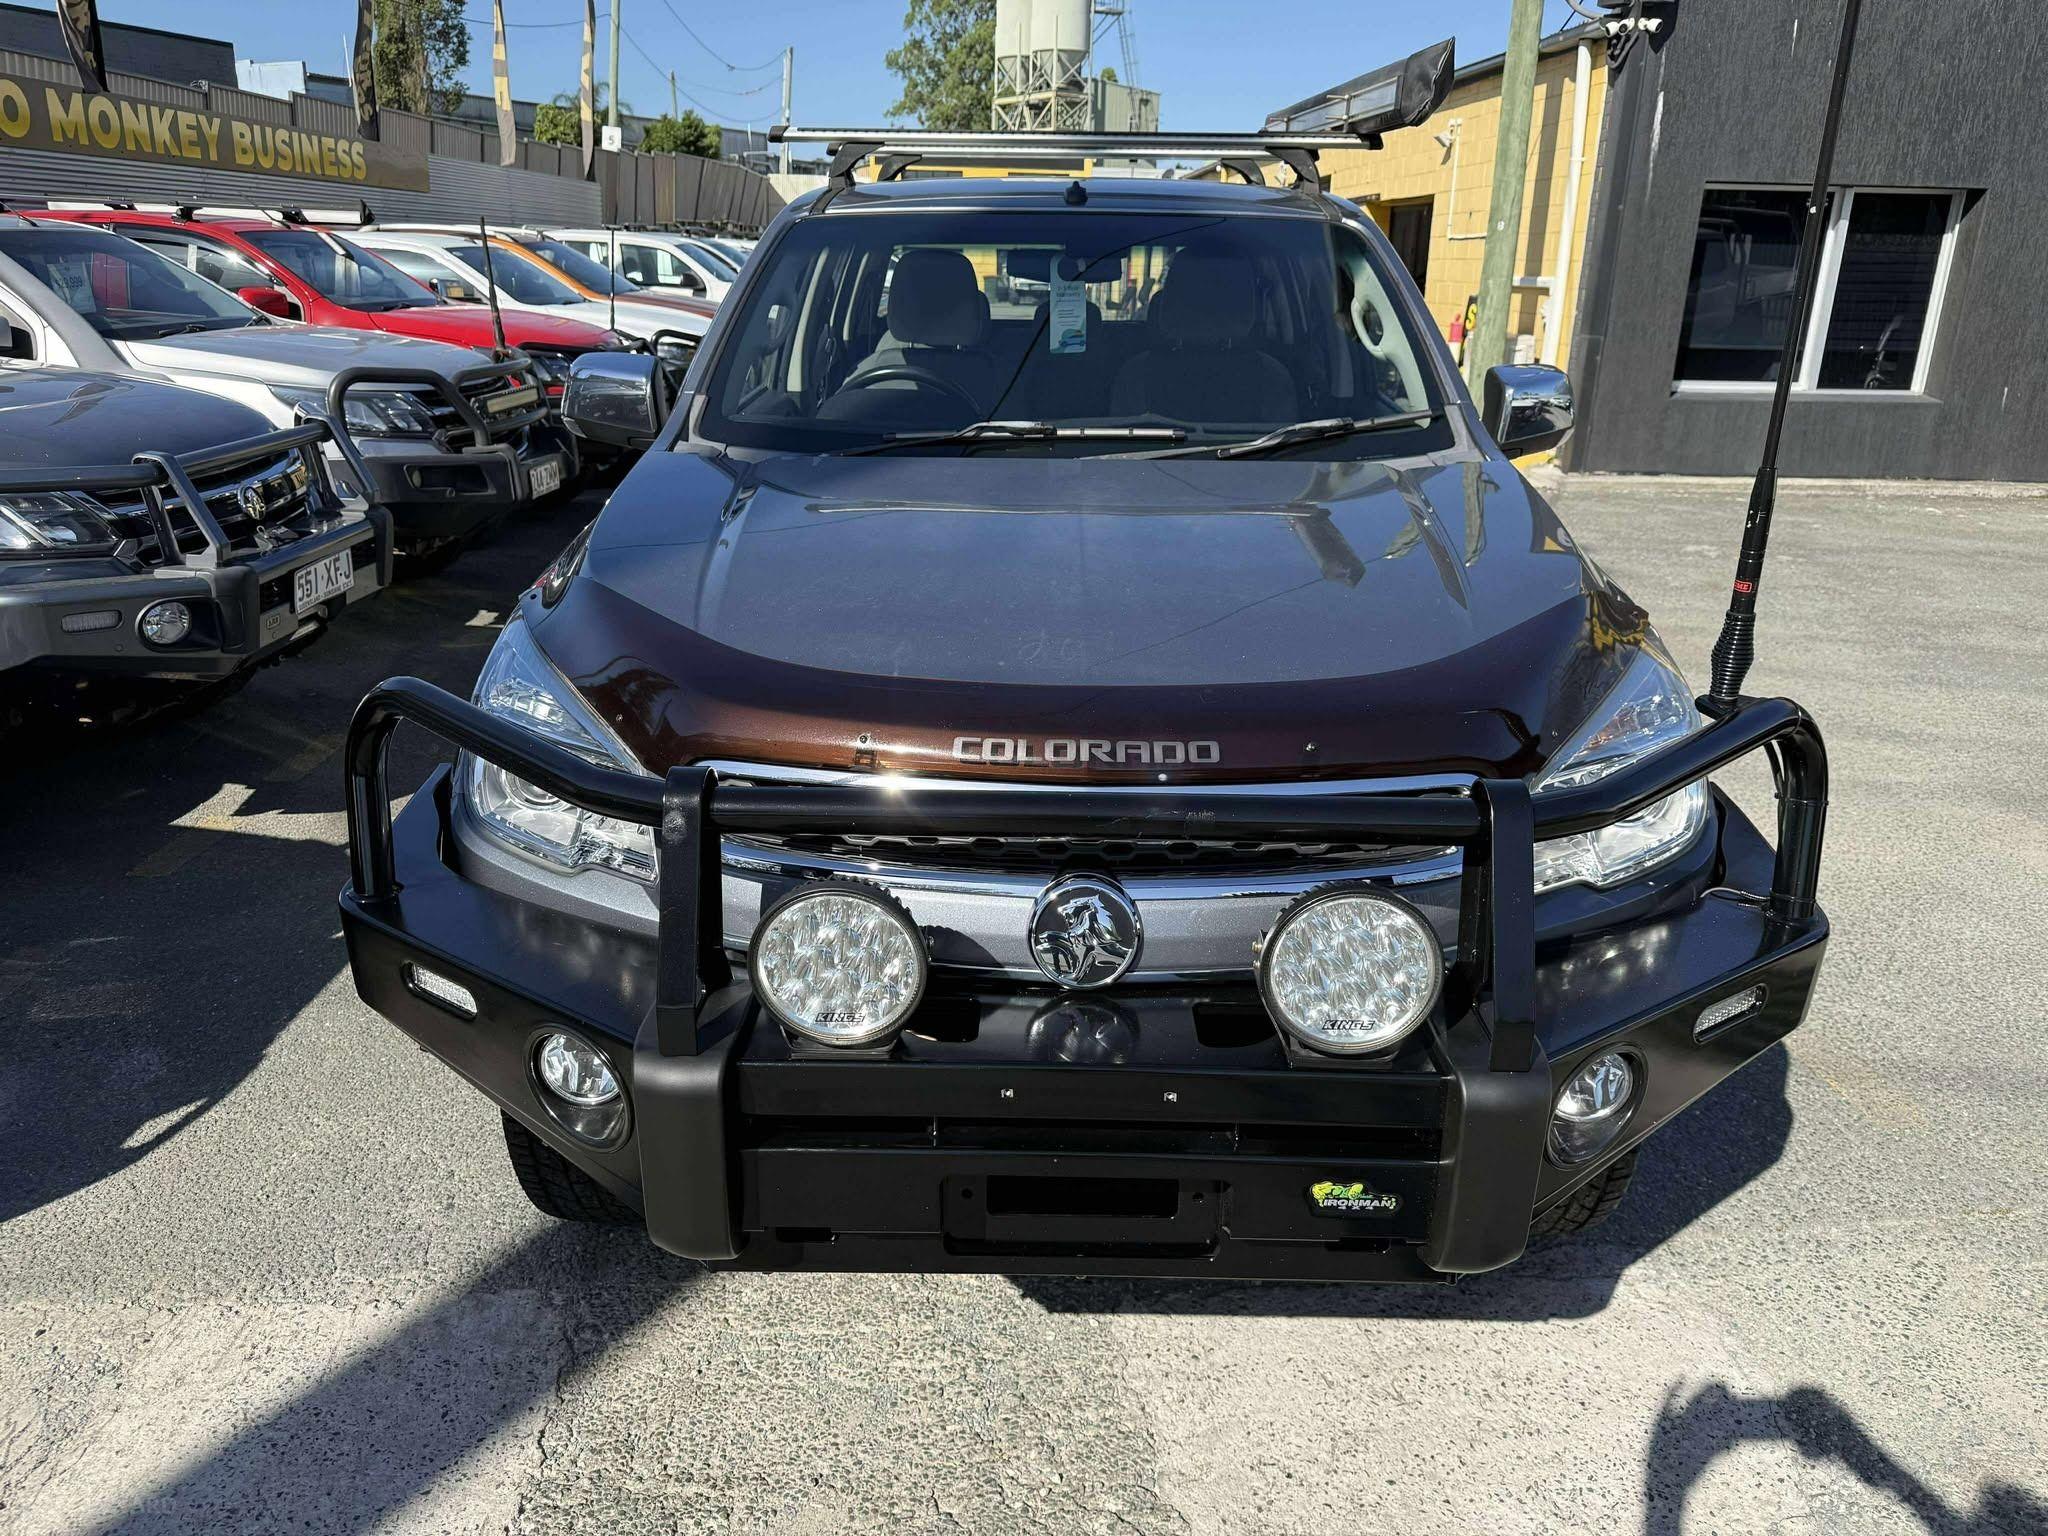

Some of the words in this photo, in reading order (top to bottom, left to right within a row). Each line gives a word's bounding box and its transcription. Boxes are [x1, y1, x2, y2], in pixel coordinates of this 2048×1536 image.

[45, 87, 220, 161] MONKEY
[231, 120, 367, 181] BUSINESS
[952, 736, 1221, 765] COLORADO
[815, 1012, 866, 1023] KINGS
[1321, 1019, 1376, 1031] KINGS
[1323, 1199, 1391, 1207] IRONMAN
